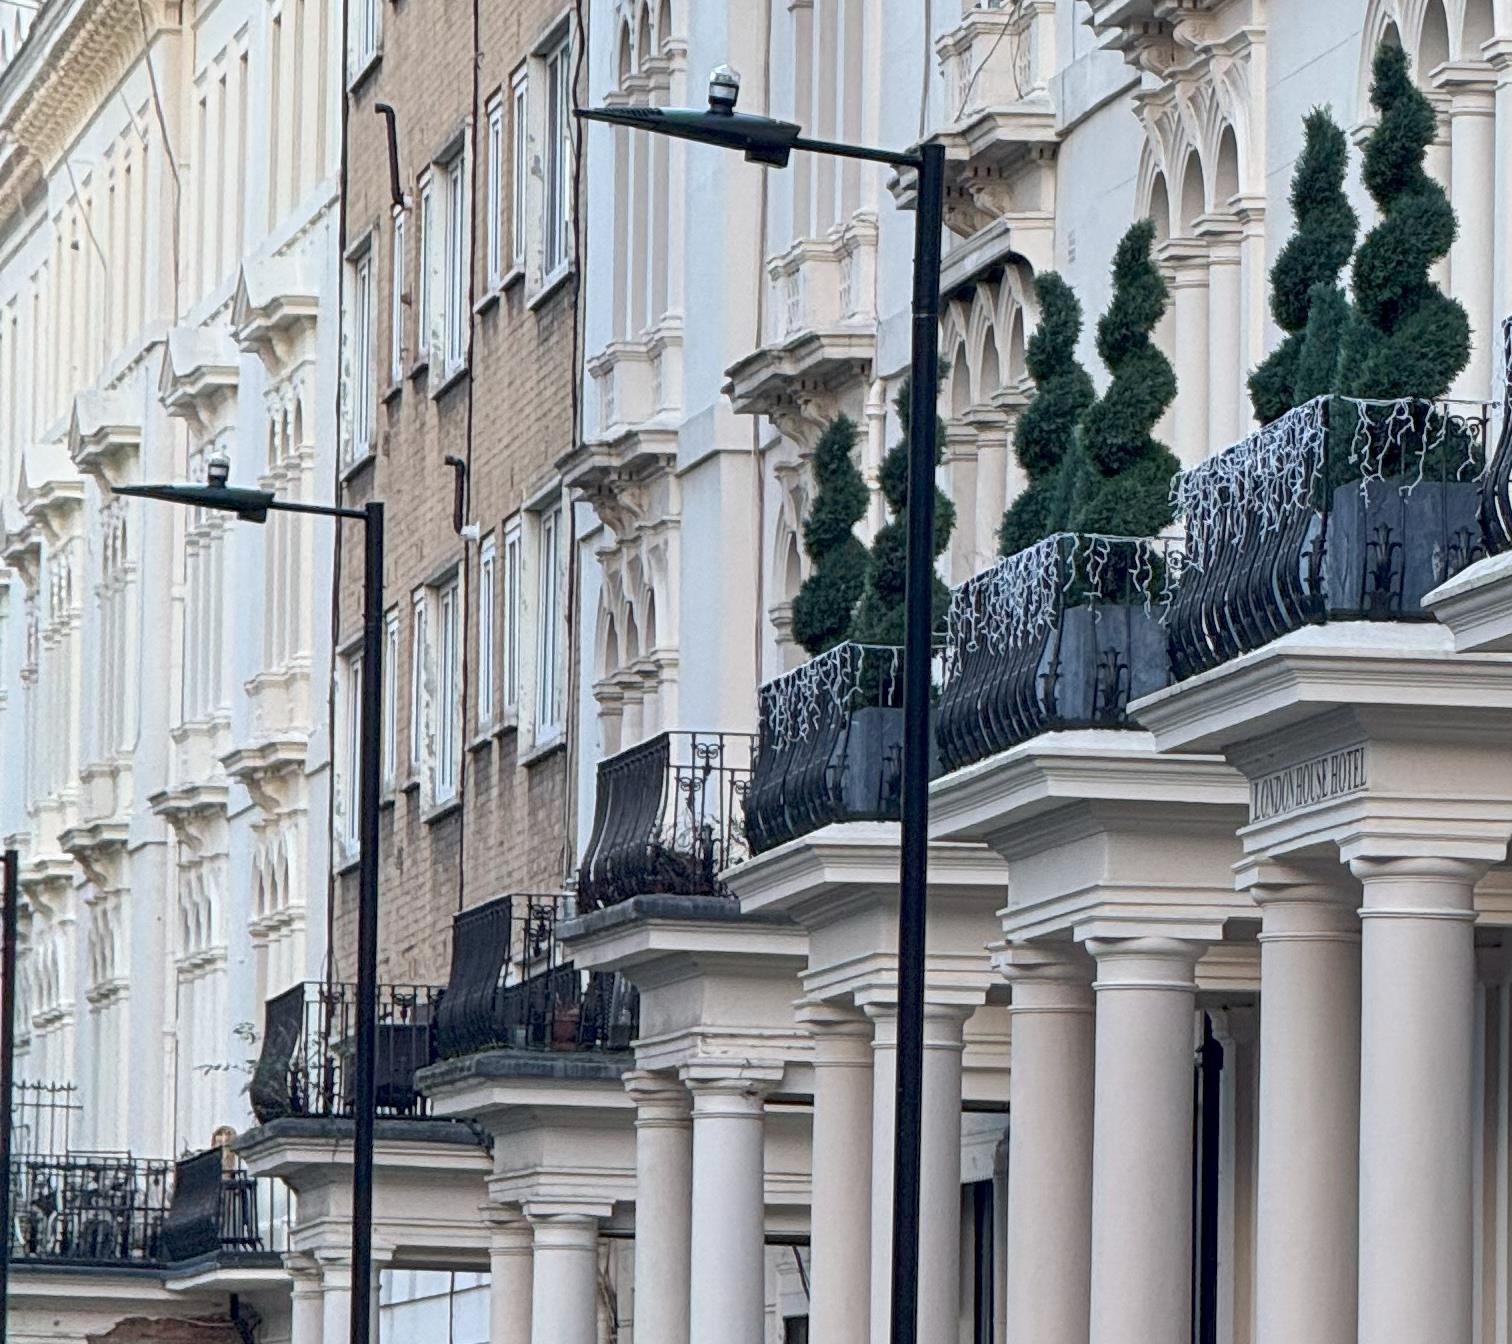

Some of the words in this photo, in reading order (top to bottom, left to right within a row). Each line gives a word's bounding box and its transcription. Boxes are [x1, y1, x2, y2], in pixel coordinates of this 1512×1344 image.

[1254, 767, 1295, 820] LONDON
[1296, 758, 1328, 807] HOUSE
[1330, 747, 1367, 795] HOTEL
